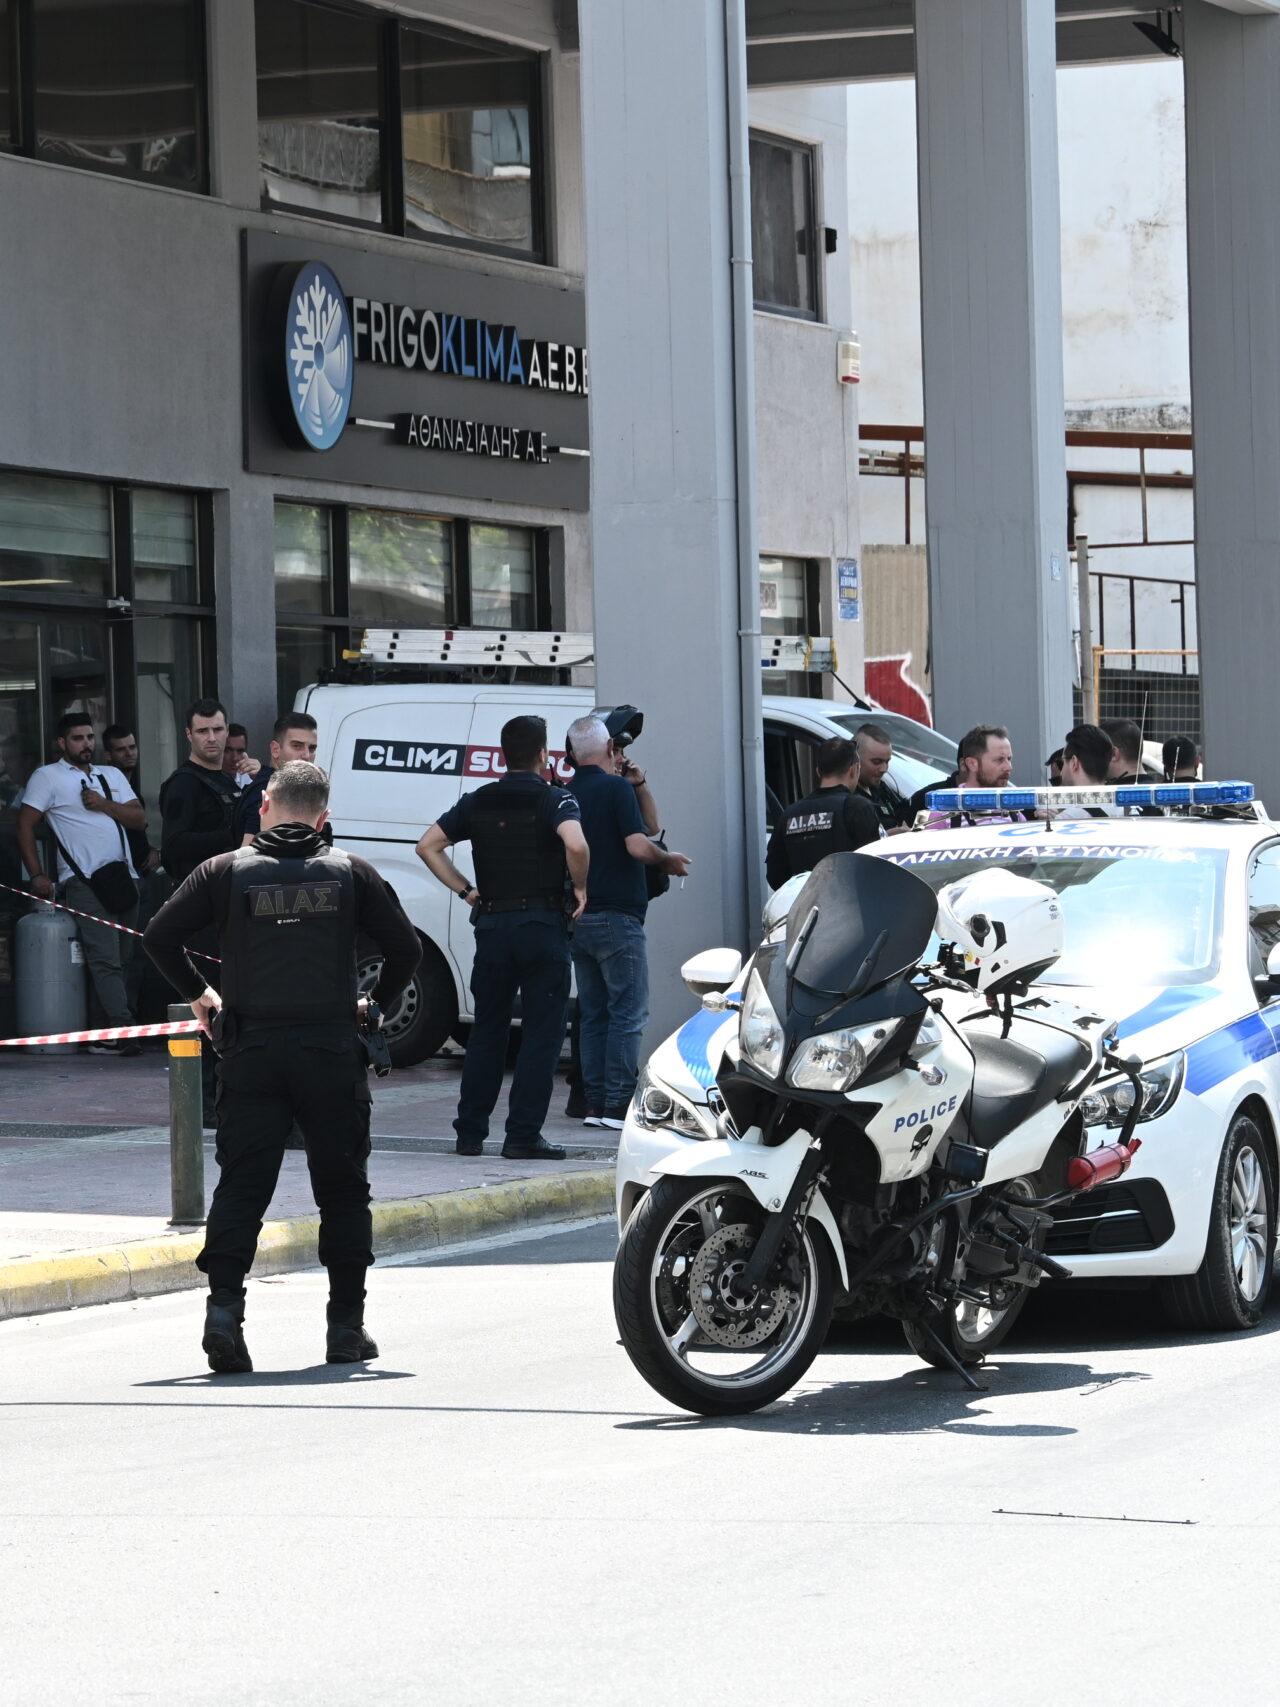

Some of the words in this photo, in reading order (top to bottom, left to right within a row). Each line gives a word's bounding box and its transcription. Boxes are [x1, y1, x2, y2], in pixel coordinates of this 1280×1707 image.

[353, 297, 525, 385] FRIGOKLIMA
[408, 414, 520, 459] ΑΘΑΝΑΣΙΑΔΗΣ
[526, 431, 551, 463] Α.Ε.
[365, 744, 458, 772] CLIMA
[789, 812, 831, 830] ΔΙ.ΑΣ.
[885, 846, 1014, 866] ΛΛΗΝΙΚΗ
[254, 888, 338, 915] ΔΙ.ΑΣ.
[894, 1094, 957, 1133] POLICE
